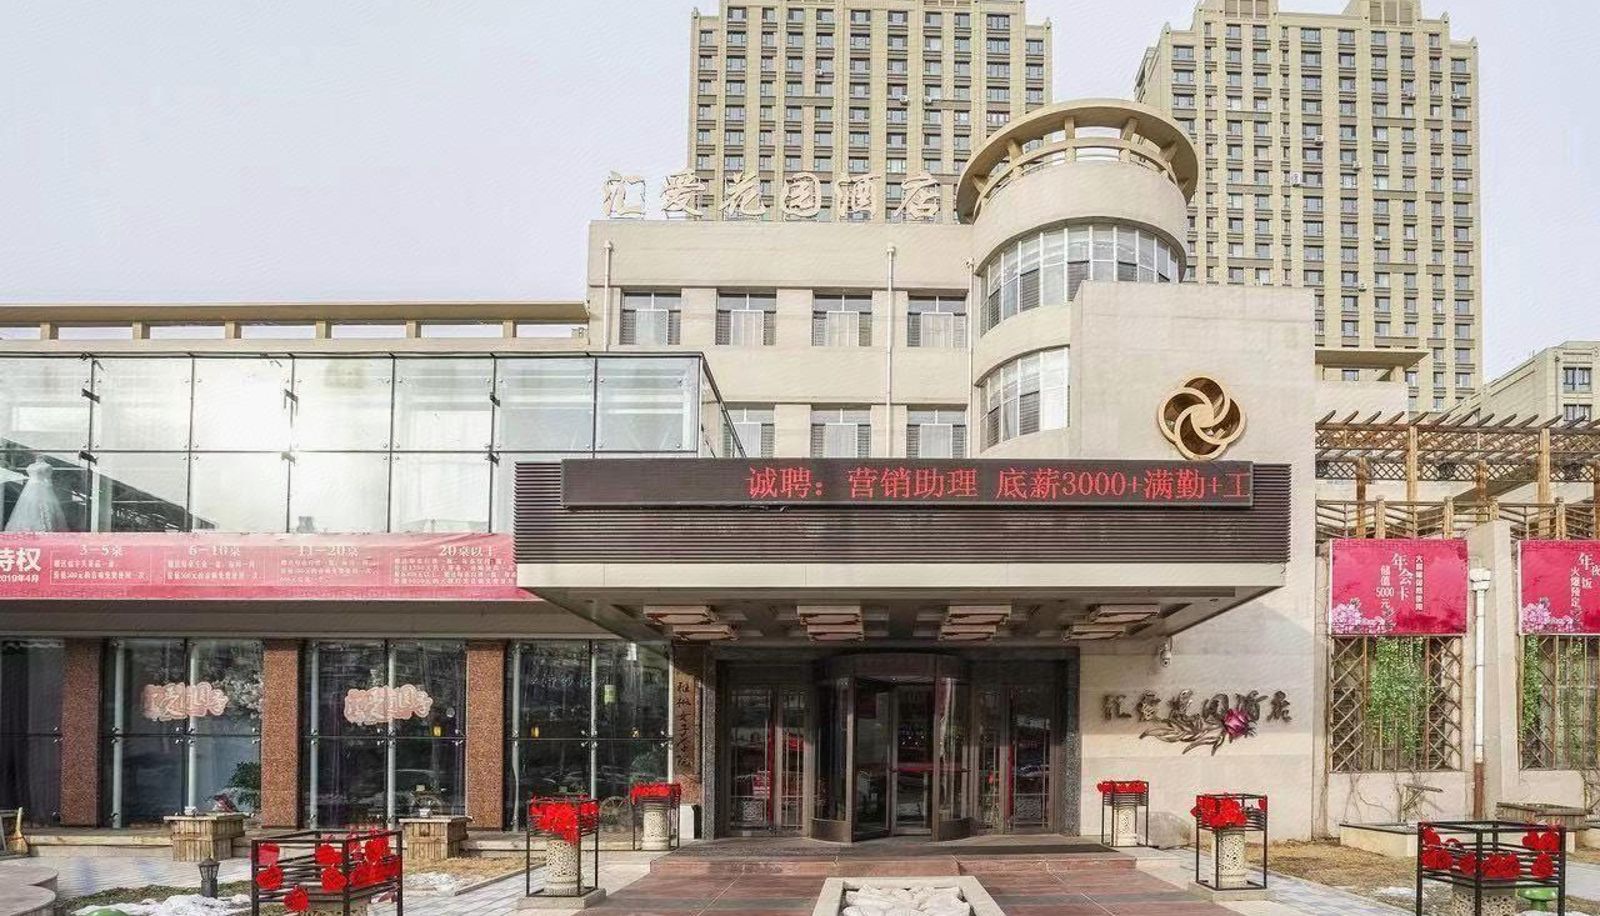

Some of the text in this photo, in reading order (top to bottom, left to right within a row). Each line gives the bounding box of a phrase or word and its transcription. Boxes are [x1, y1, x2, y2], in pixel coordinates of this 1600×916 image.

[602, 171, 941, 218] 汇爱花园酒店
[745, 467, 1250, 500] 诚聘： 营销助理 底薪3000+满勤+工
